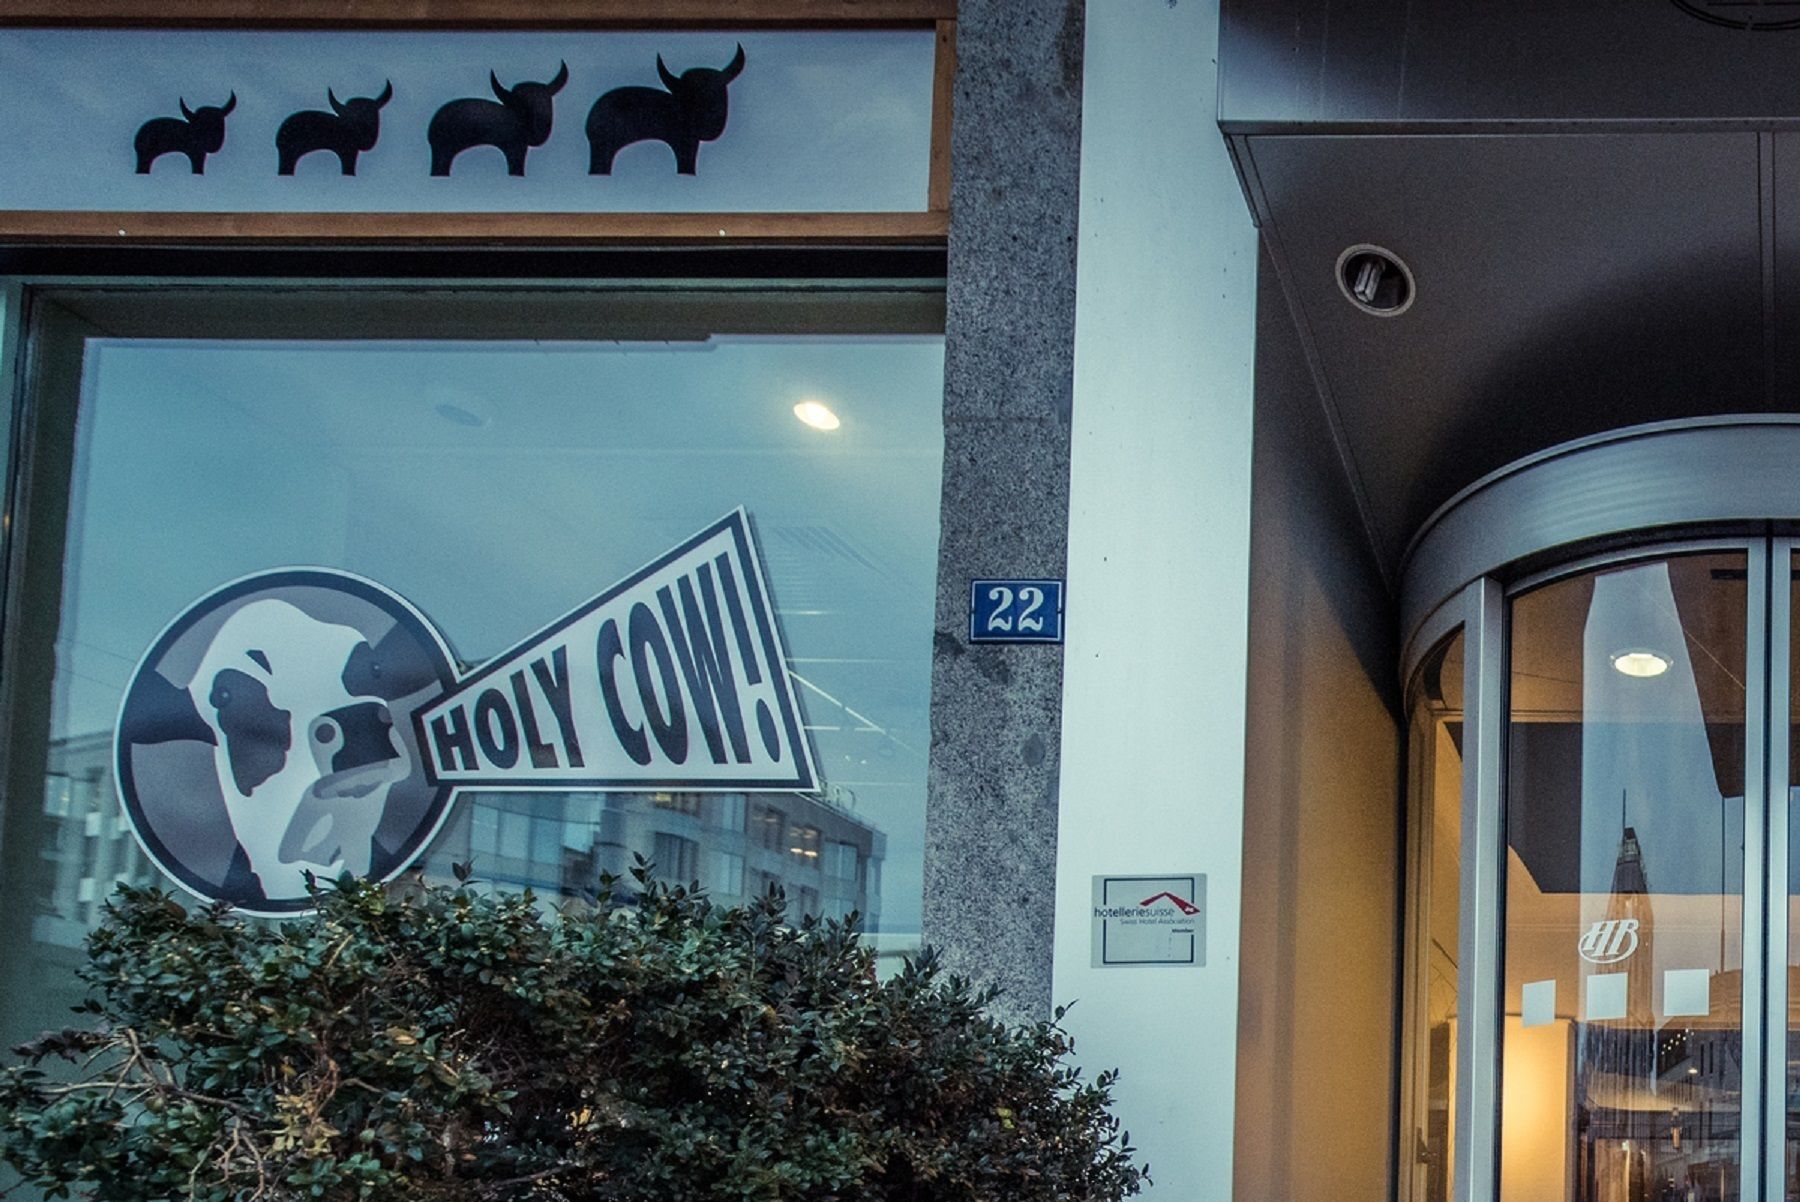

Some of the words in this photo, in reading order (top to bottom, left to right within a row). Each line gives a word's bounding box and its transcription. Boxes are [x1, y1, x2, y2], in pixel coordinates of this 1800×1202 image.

[987, 586, 1044, 632] 22
[430, 644, 586, 772] HOLY
[596, 551, 782, 767] COW!
[1094, 906, 1176, 918] hotelleriesuisse
[1578, 918, 1641, 964] HB
